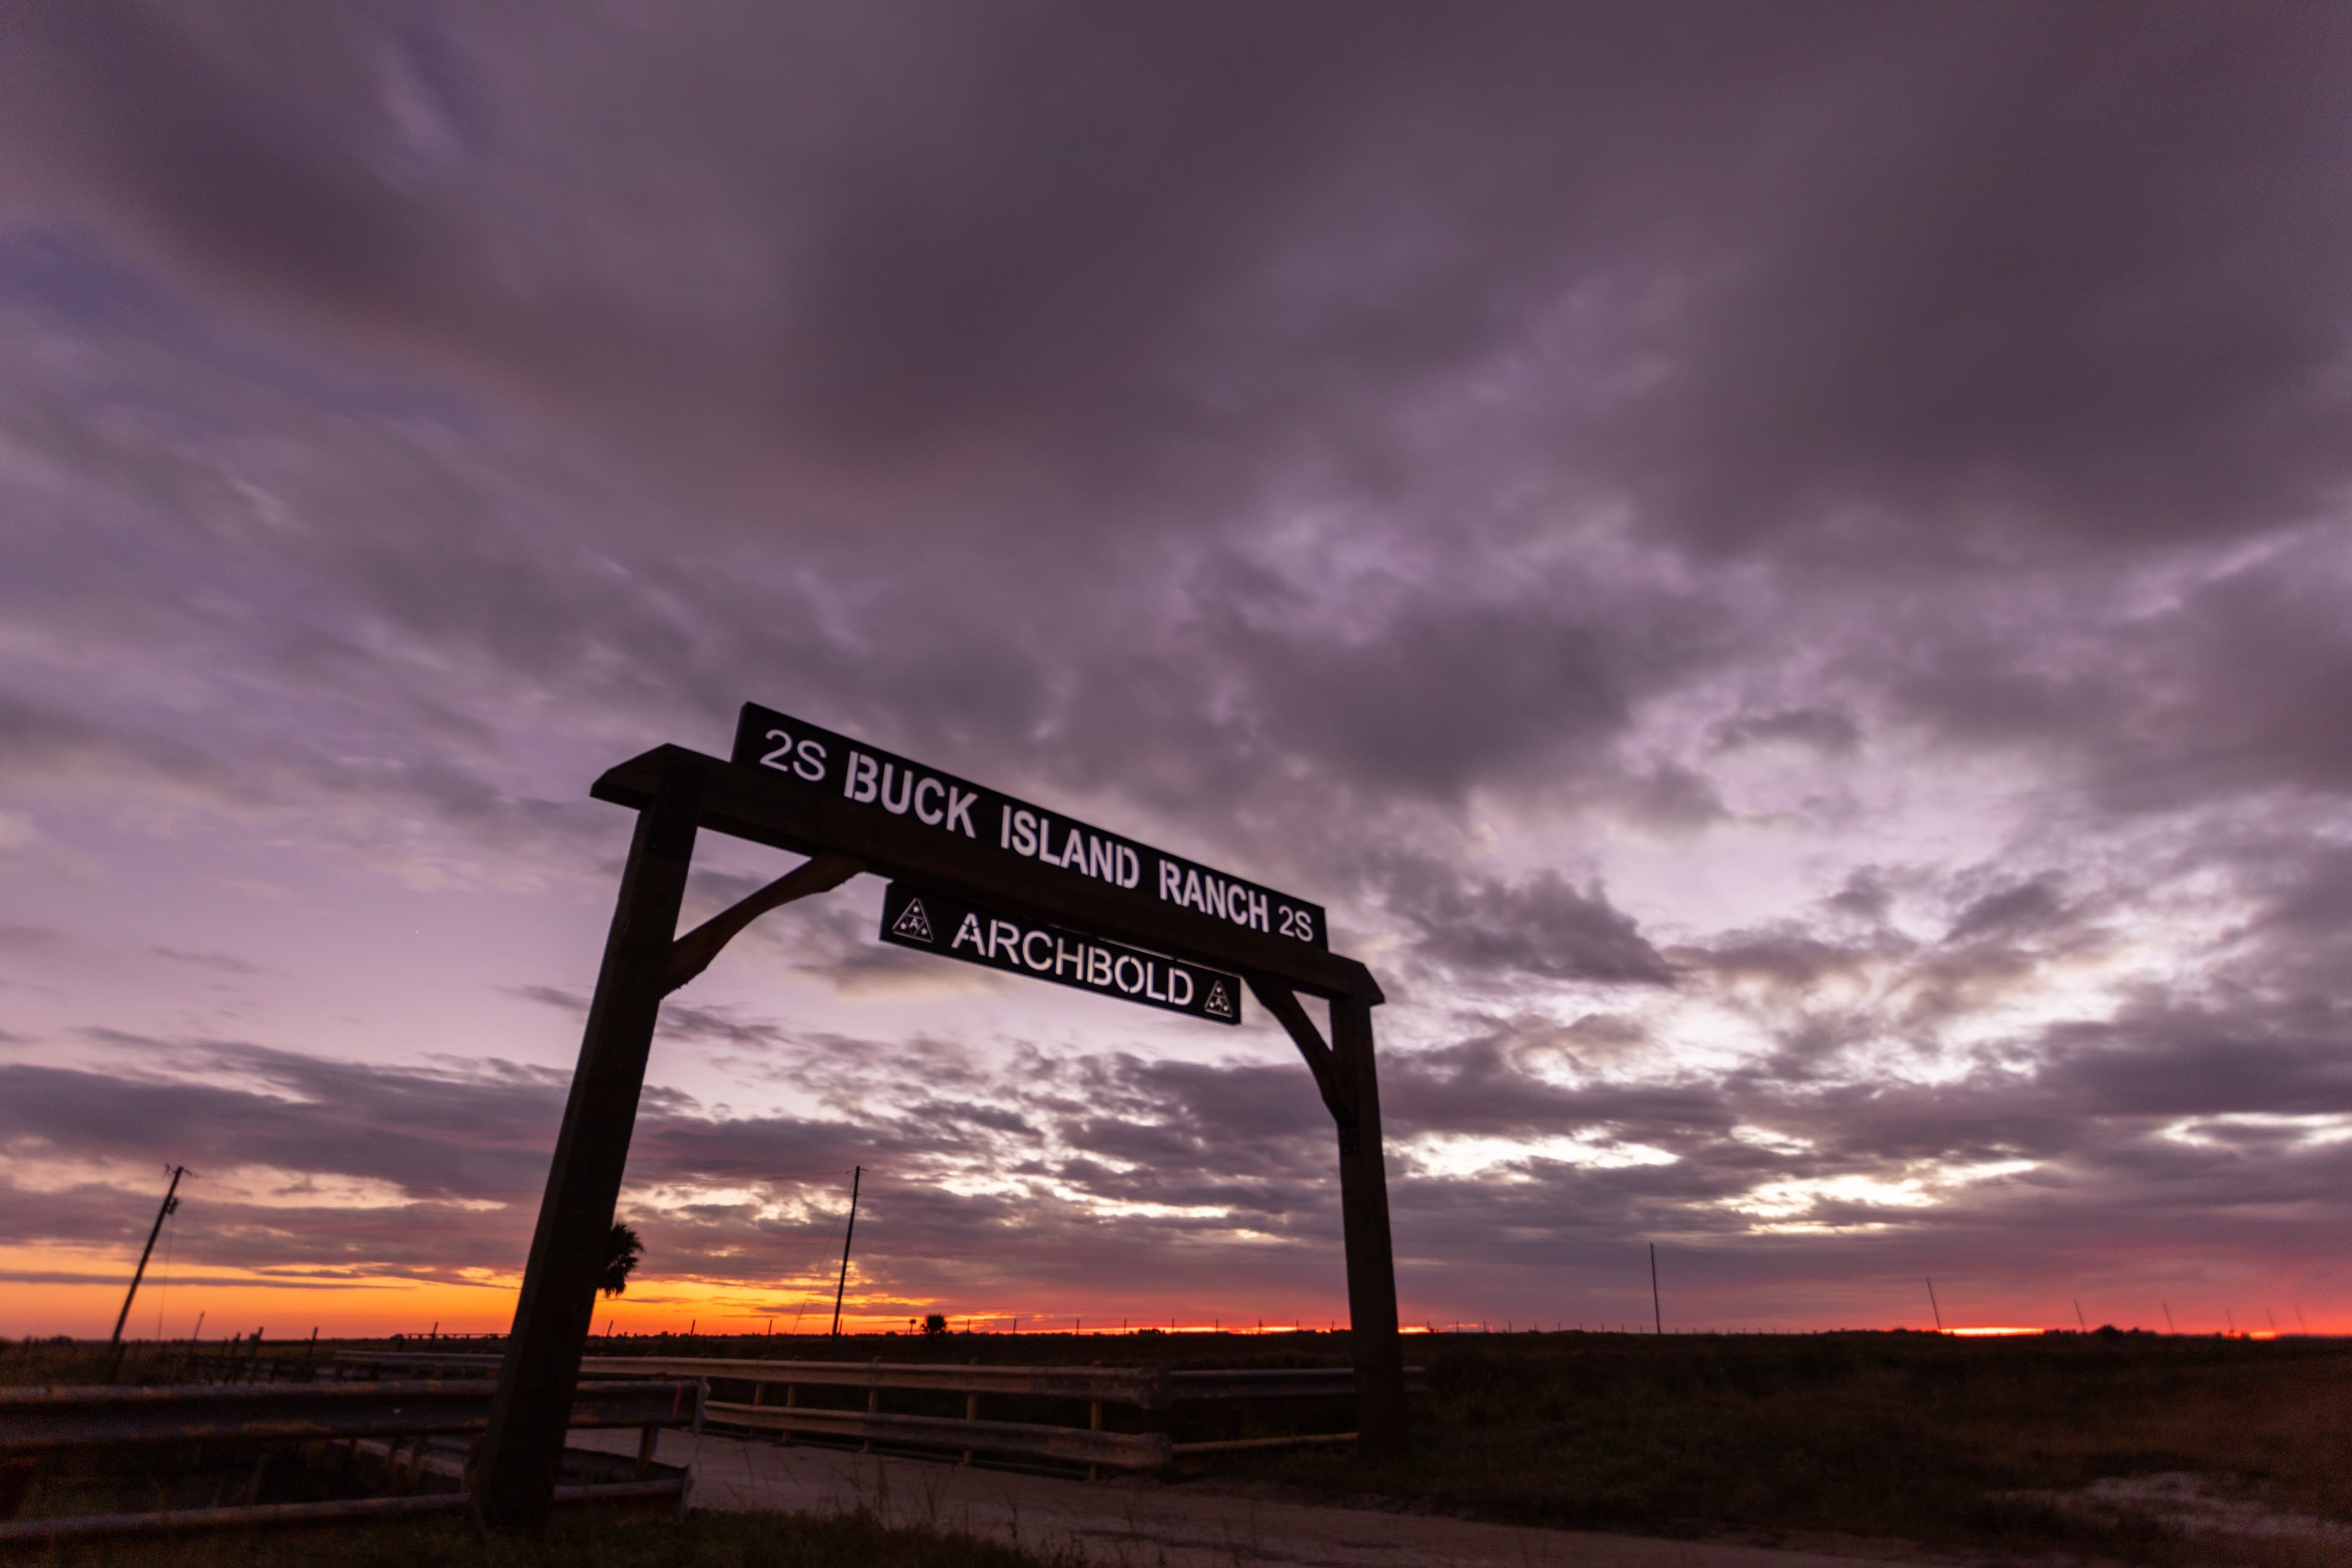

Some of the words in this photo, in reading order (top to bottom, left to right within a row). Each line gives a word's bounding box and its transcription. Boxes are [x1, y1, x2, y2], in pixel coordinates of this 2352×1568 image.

[760, 729, 826, 781] 2S
[844, 751, 978, 839] BUCK
[1001, 805, 1139, 889] ISLAND
[1159, 859, 1269, 933] RANCH
[1278, 905, 1313, 942] 2S
[951, 913, 1194, 1006] ARCHBOLD
